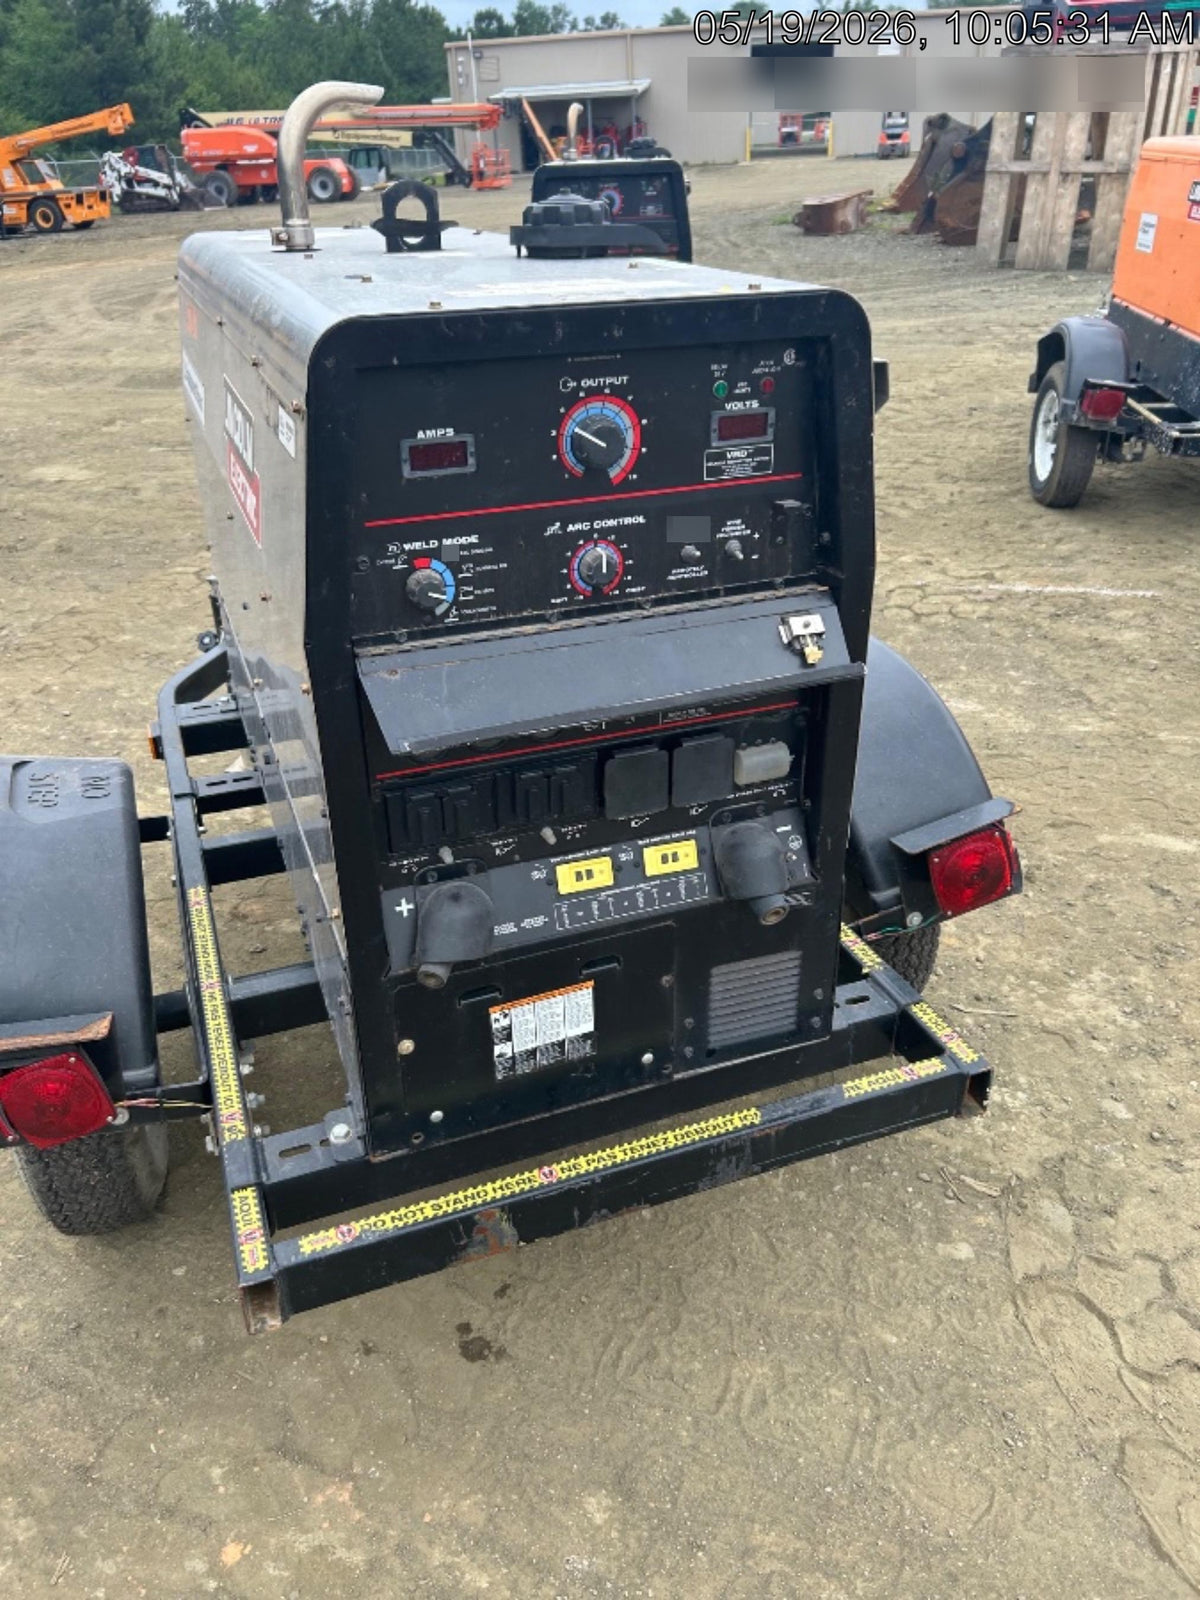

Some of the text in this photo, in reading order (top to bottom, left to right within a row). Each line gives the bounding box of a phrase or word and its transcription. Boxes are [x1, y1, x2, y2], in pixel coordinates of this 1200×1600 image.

[580, 375, 629, 388] OUTPUT
[724, 399, 760, 411] VOLTS
[416, 427, 455, 440] AMPS
[566, 514, 647, 533] ARC CONTROL
[402, 534, 479, 552] WELD MODE
[585, 1150, 618, 1168] PAS
[620, 1136, 669, 1158] TENEZ
[672, 1119, 736, 1142] DEBOUT
[389, 1206, 428, 1224] NOT
[430, 1189, 489, 1212] STAND
[491, 1175, 538, 1196] HERE
